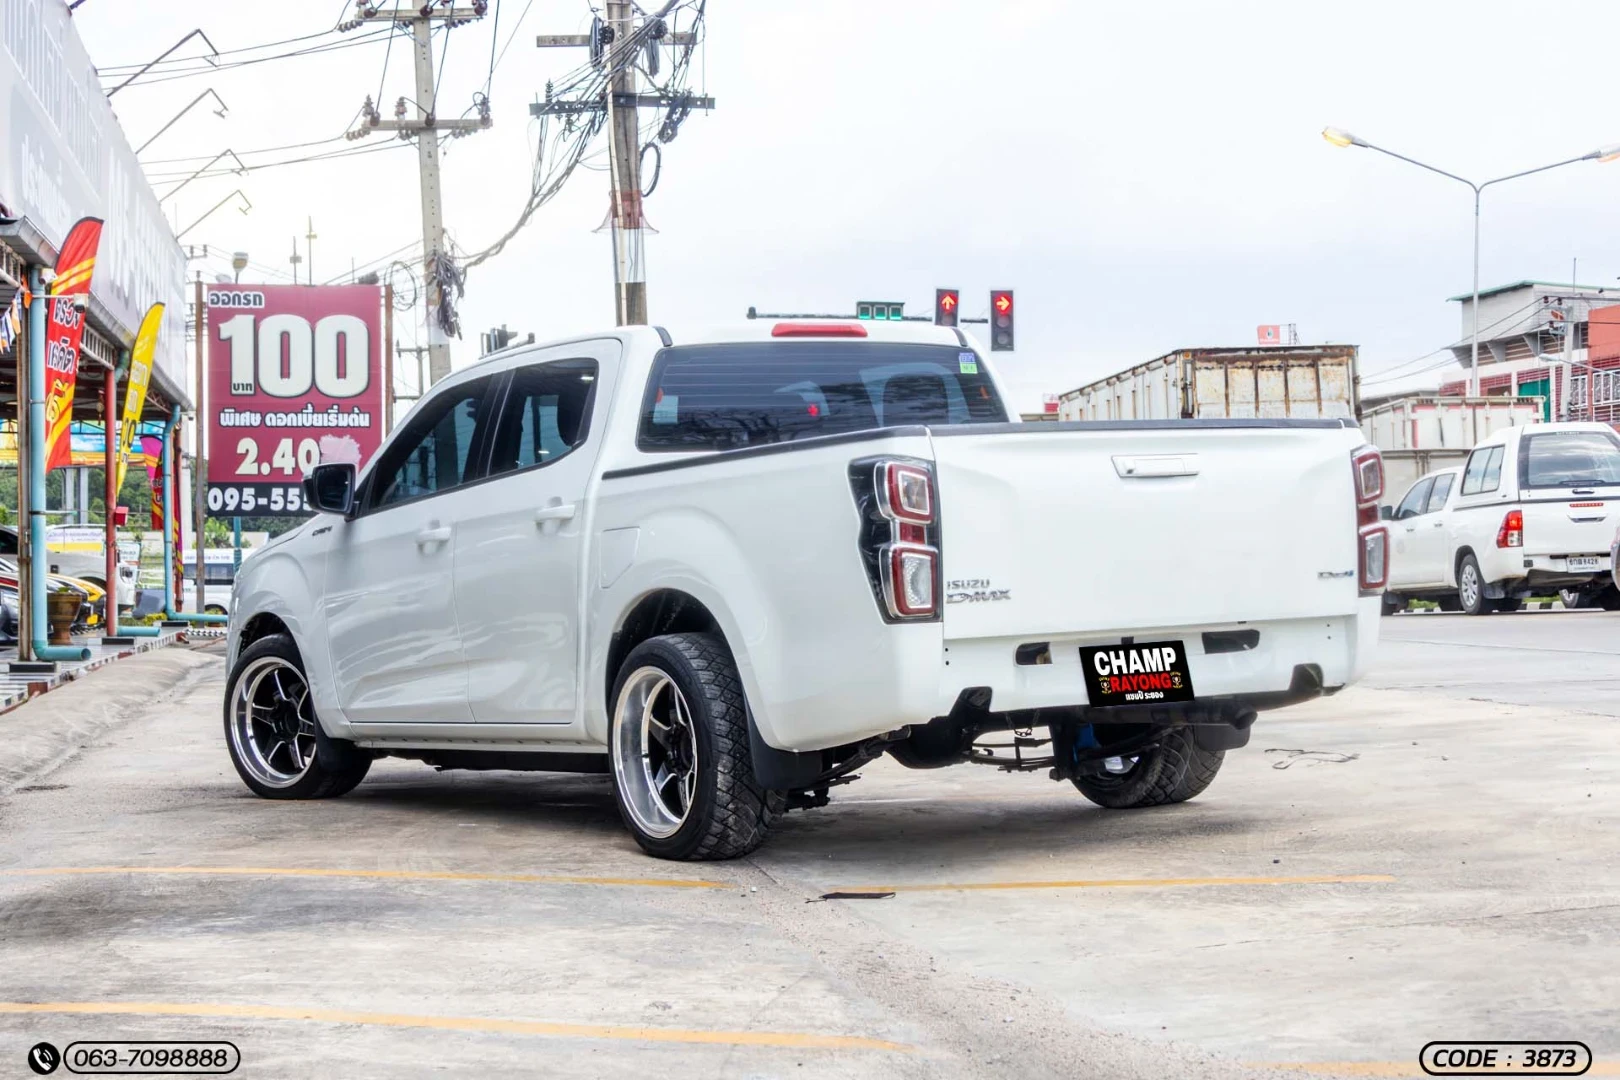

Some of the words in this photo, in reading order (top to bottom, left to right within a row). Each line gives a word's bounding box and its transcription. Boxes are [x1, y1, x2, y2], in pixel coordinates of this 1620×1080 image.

[219, 314, 369, 398] 100
[232, 382, 253, 392] บาท
[219, 407, 262, 427] พิเศษ
[946, 579, 990, 590] ISUZU
